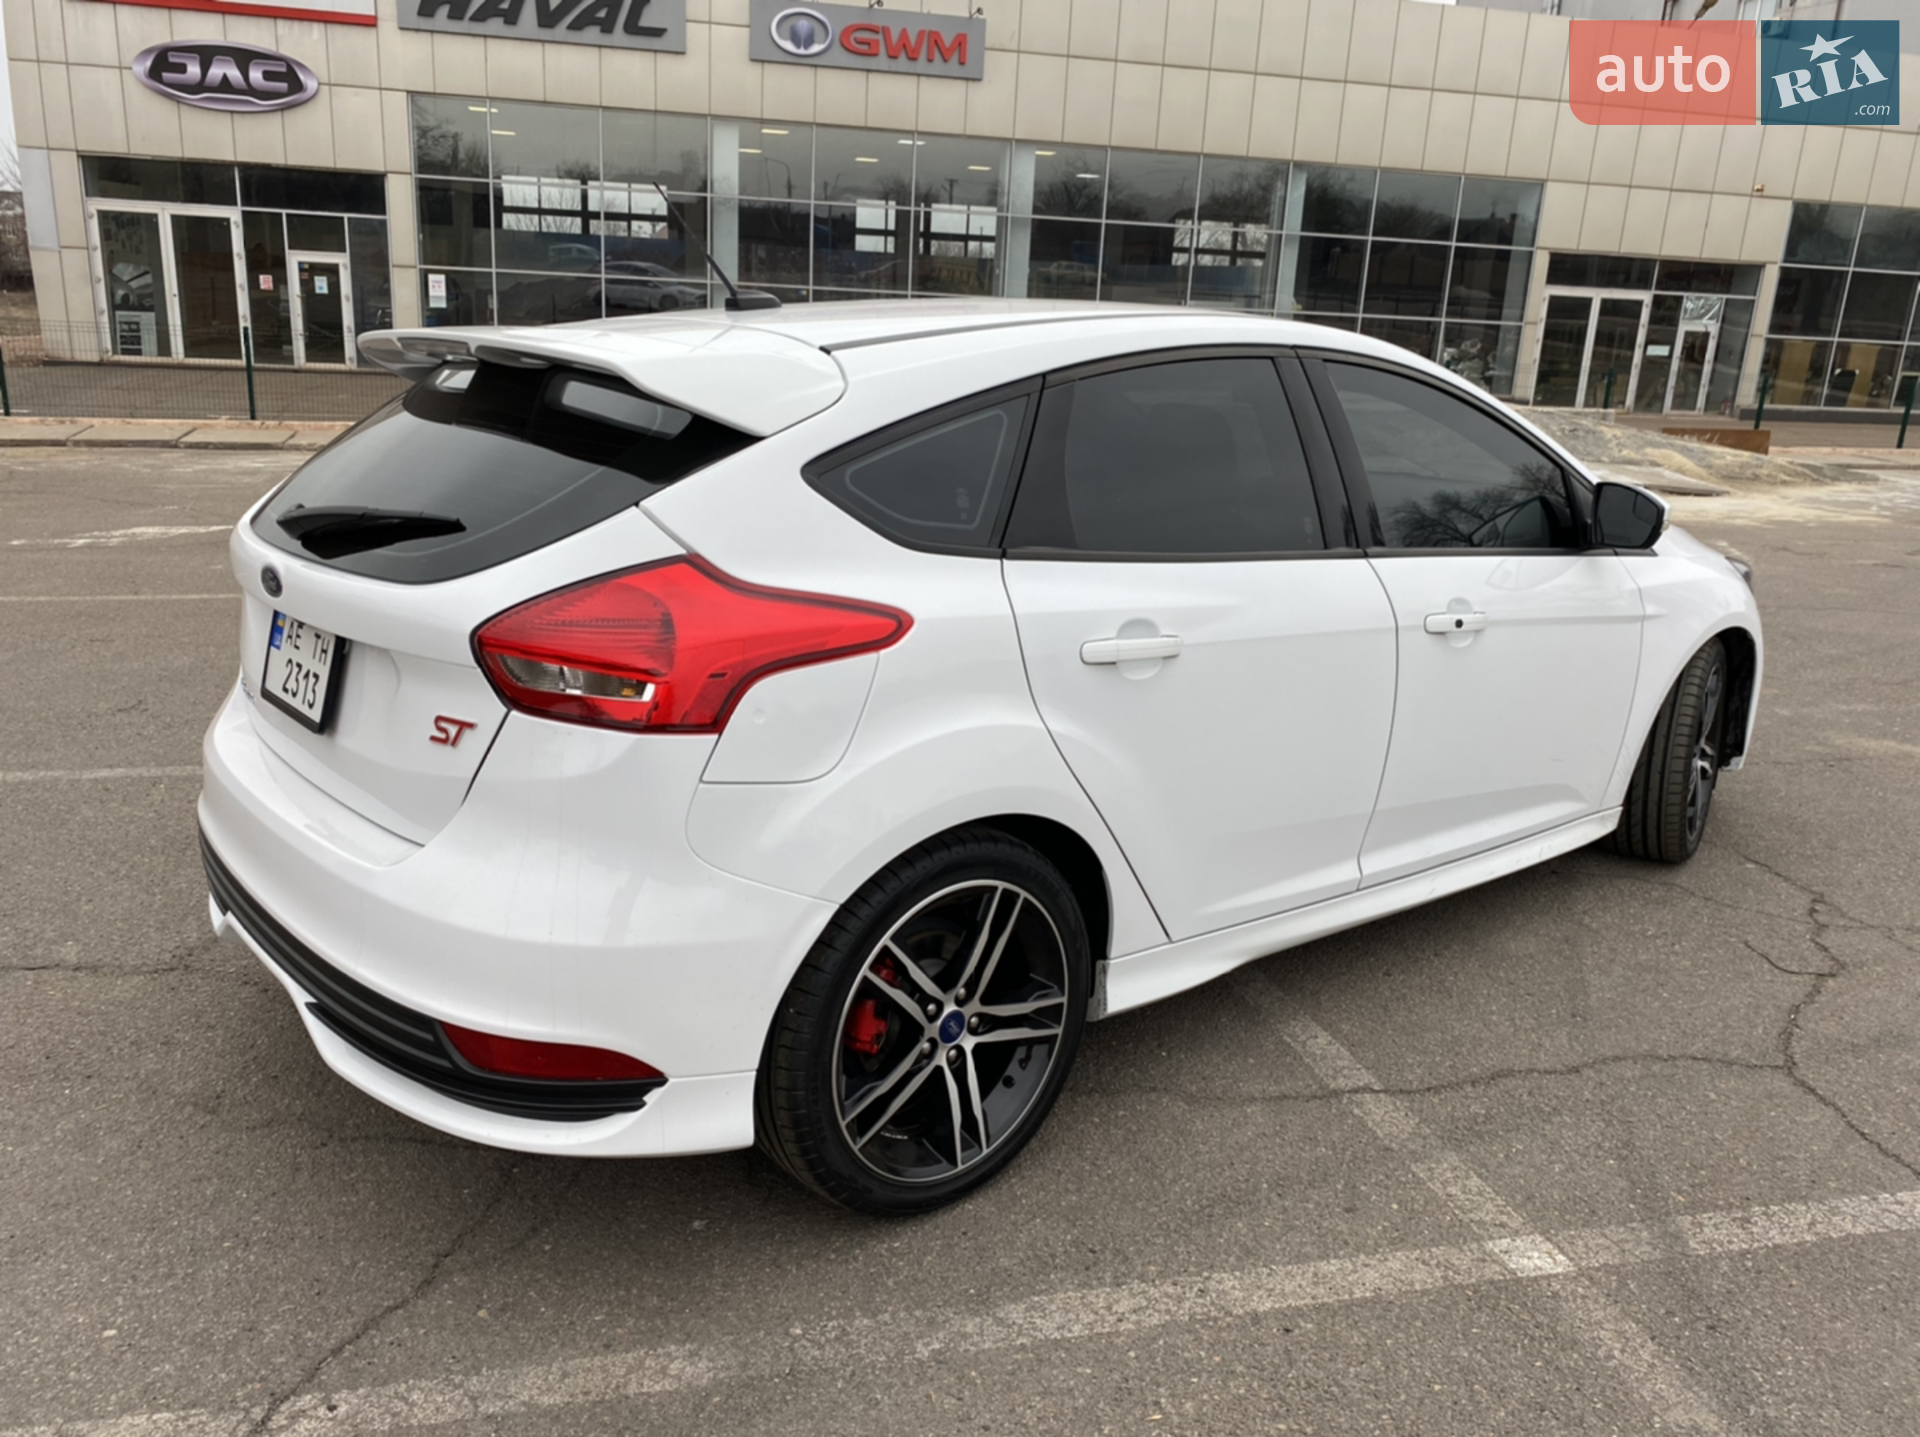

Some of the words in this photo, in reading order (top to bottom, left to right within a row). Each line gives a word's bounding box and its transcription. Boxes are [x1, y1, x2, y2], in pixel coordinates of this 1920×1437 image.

[839, 22, 968, 65] GWM
[161, 51, 289, 93] JAC
[285, 620, 303, 651] AE
[312, 632, 330, 666] TH
[282, 657, 320, 710] 2313
[429, 715, 477, 747] ST
